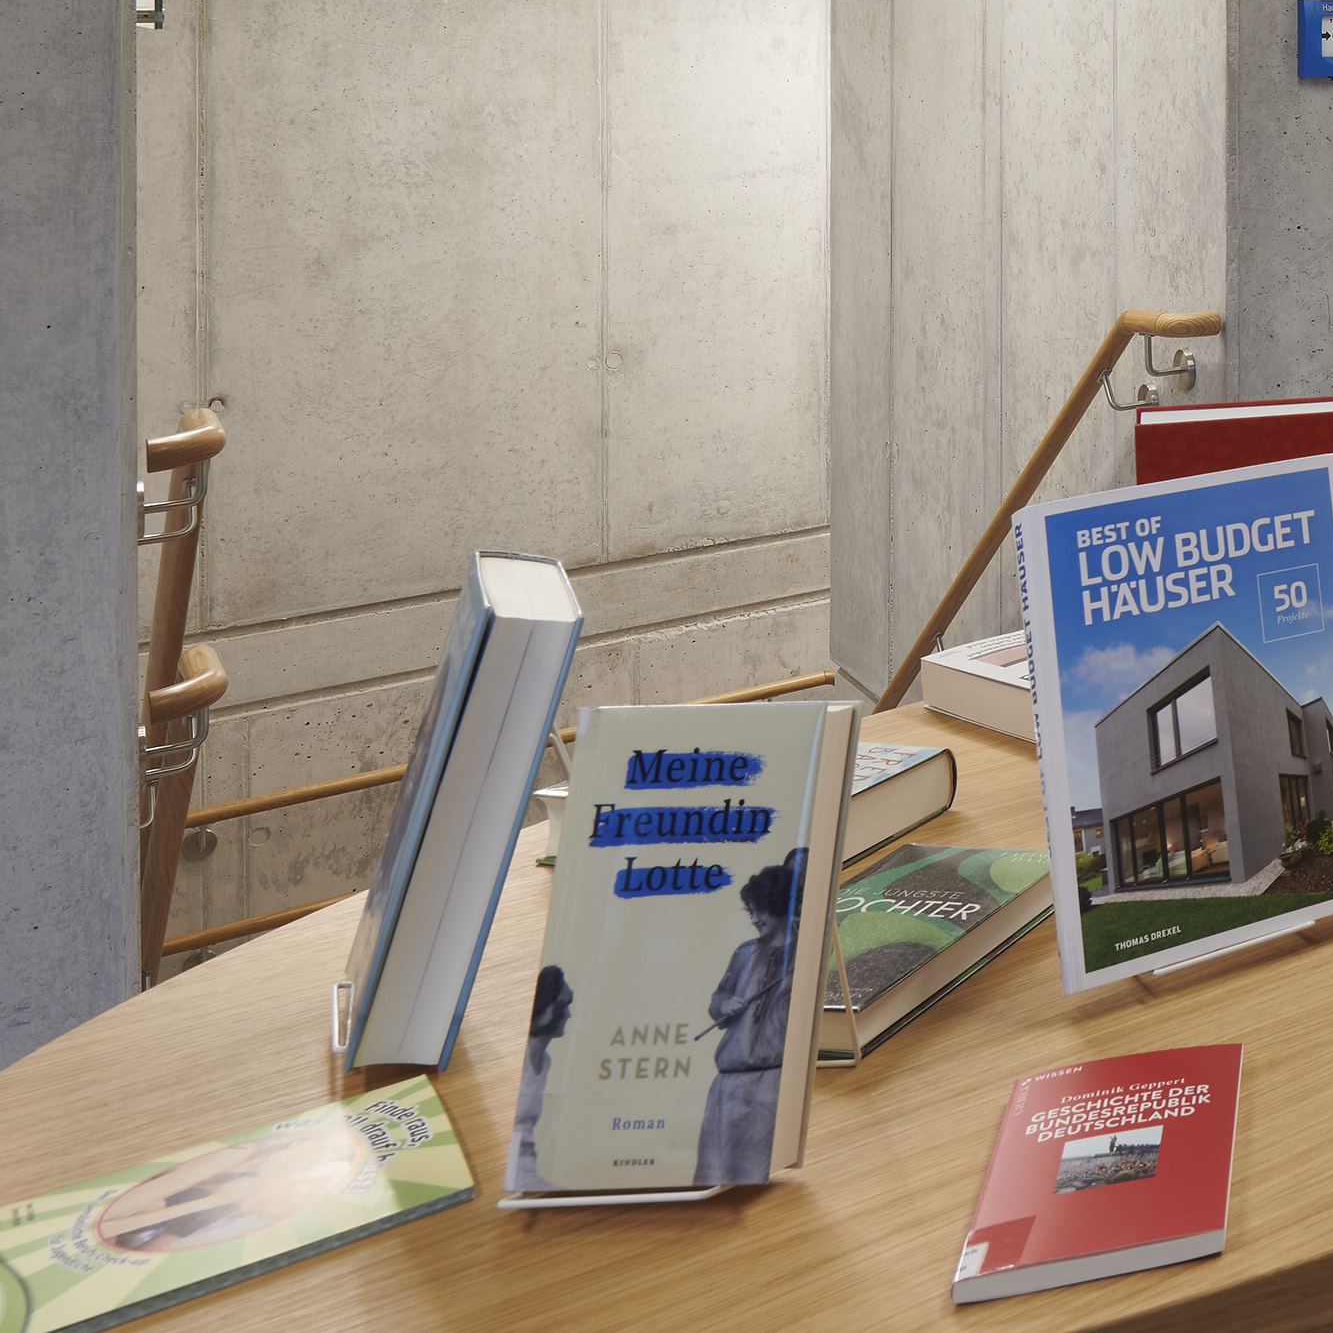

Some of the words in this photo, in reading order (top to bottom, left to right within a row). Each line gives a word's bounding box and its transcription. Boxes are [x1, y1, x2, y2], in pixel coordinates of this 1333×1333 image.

[1076, 520, 1131, 548] BEST
[1135, 516, 1162, 540] OF
[1078, 536, 1164, 587] LOW
[1174, 510, 1316, 569] BUDGET
[1083, 562, 1236, 626] HÄUSER
[1273, 580, 1308, 614] 50
[1276, 609, 1310, 626] Projekte
[626, 748, 751, 786] Meine
[589, 800, 772, 841] Freundin
[619, 855, 725, 894] Lotte
[835, 897, 982, 920] OCHTER
[838, 887, 870, 896] DIE
[873, 888, 965, 899] JÜNGSTE
[1114, 931, 1149, 952] THOMAS
[1150, 924, 1182, 944] DREXEL
[610, 1024, 690, 1048] ANNE
[598, 1056, 692, 1082] STERN
[1035, 1066, 1082, 1082] WISSEN
[1031, 1090, 1162, 1122] GESCHICHTE
[1168, 1084, 1210, 1098] DER
[1061, 1086, 1124, 1104] Dominik
[1128, 1077, 1186, 1092] Geppert
[364, 1100, 415, 1120] Finde
[405, 1118, 430, 1148] raus,
[611, 1115, 666, 1132] Roman
[1025, 1094, 1211, 1135] BUNDESREPUBLIK
[1037, 1106, 1196, 1142] DEUTSCHLAND
[359, 1121, 397, 1151] drauf
[612, 1158, 656, 1167] KINDLER
